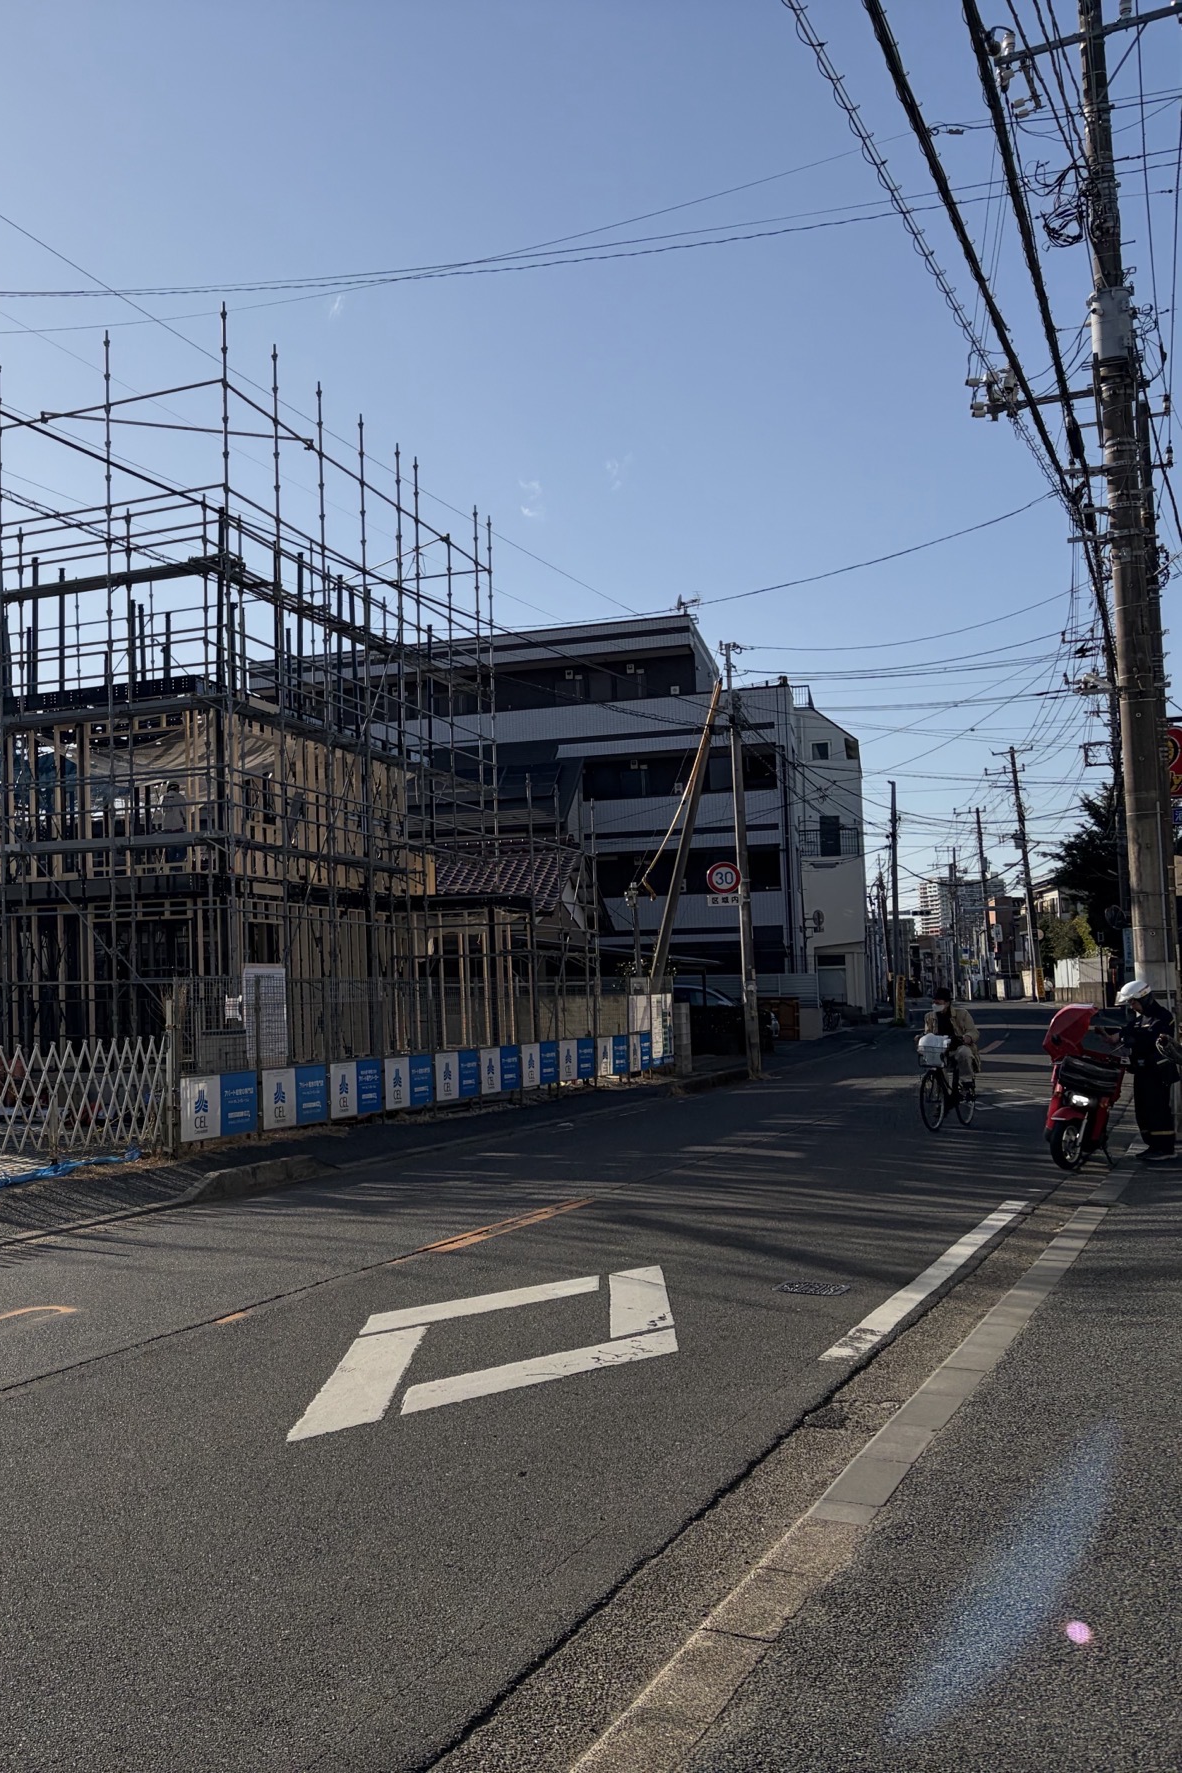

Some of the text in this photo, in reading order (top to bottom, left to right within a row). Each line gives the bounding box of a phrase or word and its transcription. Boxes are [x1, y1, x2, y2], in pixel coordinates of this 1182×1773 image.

[715, 871, 734, 886] 30
[711, 896, 739, 904] 区域内
[339, 1096, 349, 1108] CEL
[274, 1106, 286, 1118] CEL
[194, 1115, 209, 1129] CEL
